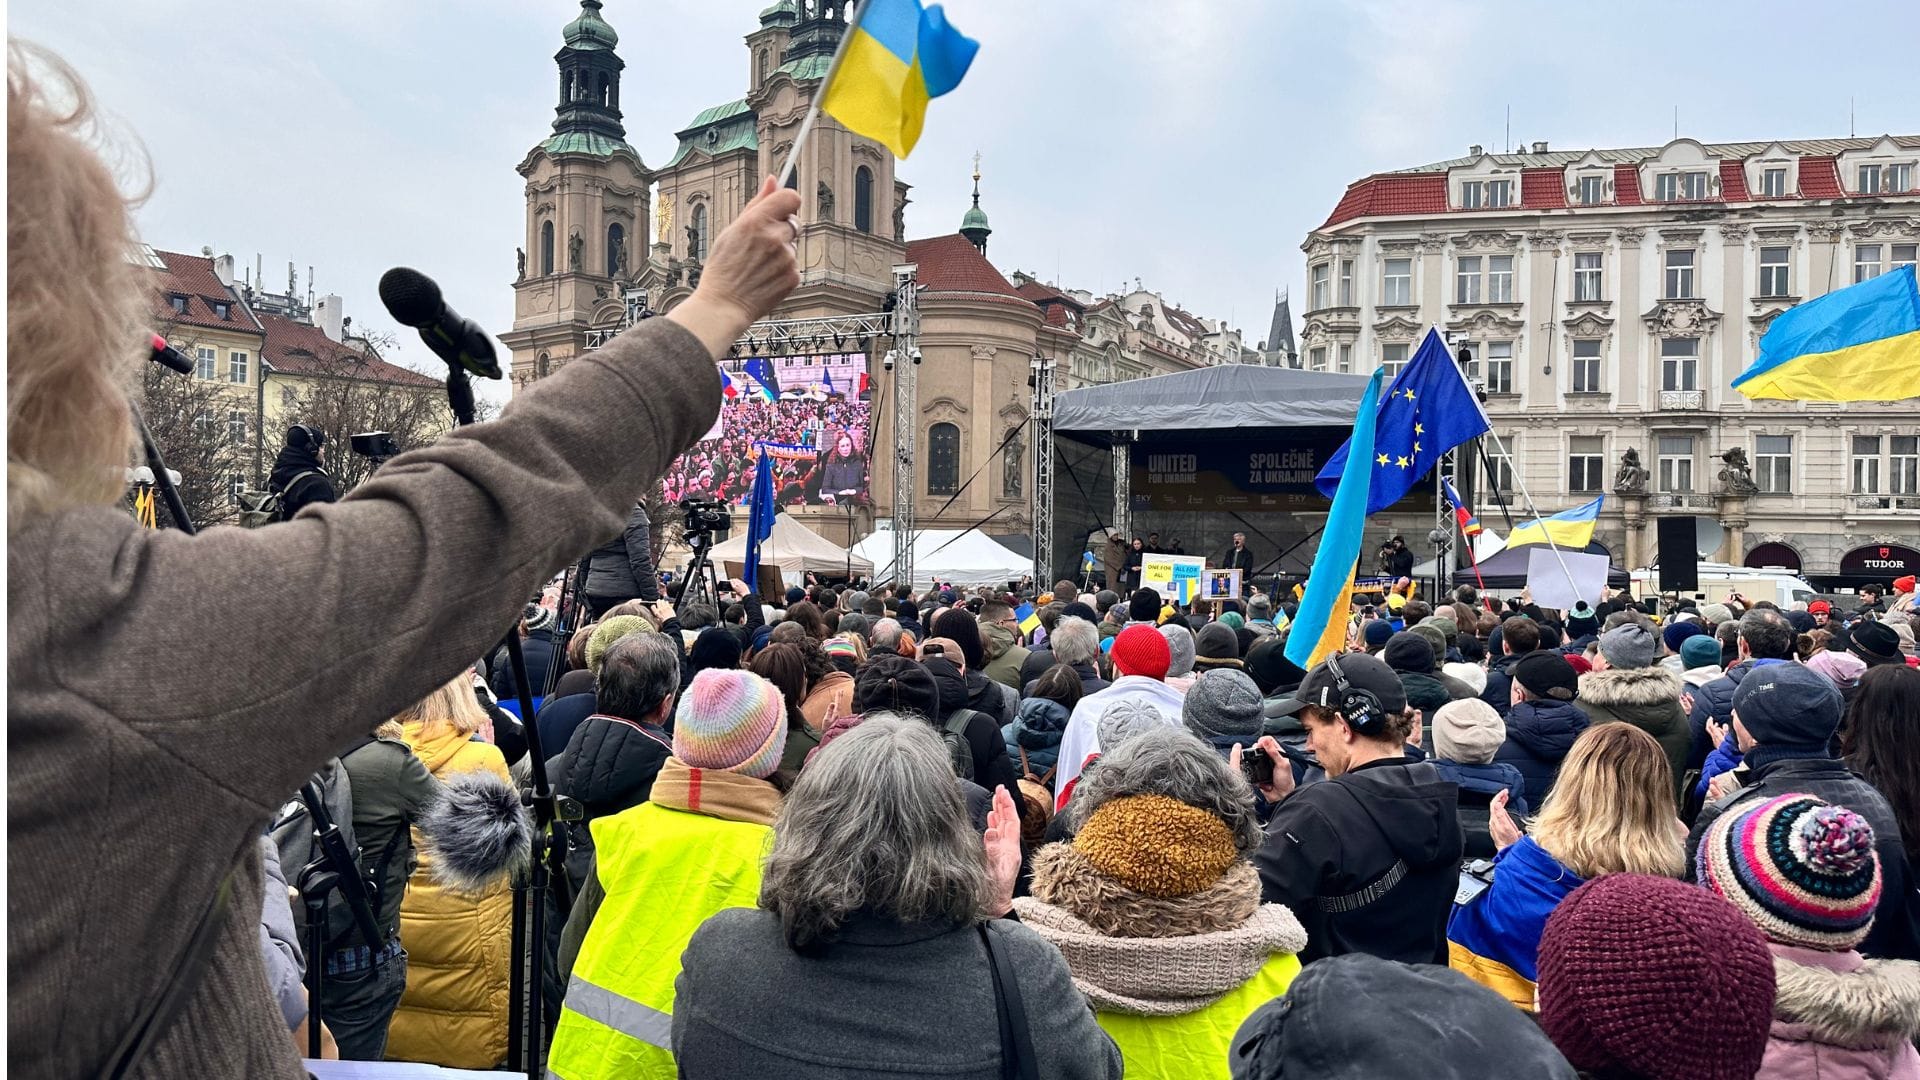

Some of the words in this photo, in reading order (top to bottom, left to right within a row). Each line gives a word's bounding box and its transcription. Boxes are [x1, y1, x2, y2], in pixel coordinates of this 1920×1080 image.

[1148, 454, 1197, 473] UNITED
[1249, 448, 1315, 469] SPOLEČNĚ
[1148, 473, 1163, 484] FOR
[1164, 473, 1197, 484] UKRAINE
[1249, 470, 1262, 483] ZA
[1264, 470, 1315, 483] UKRAJINU
[1160, 564, 1172, 572] FOR
[1864, 560, 1905, 569] TUDOR
